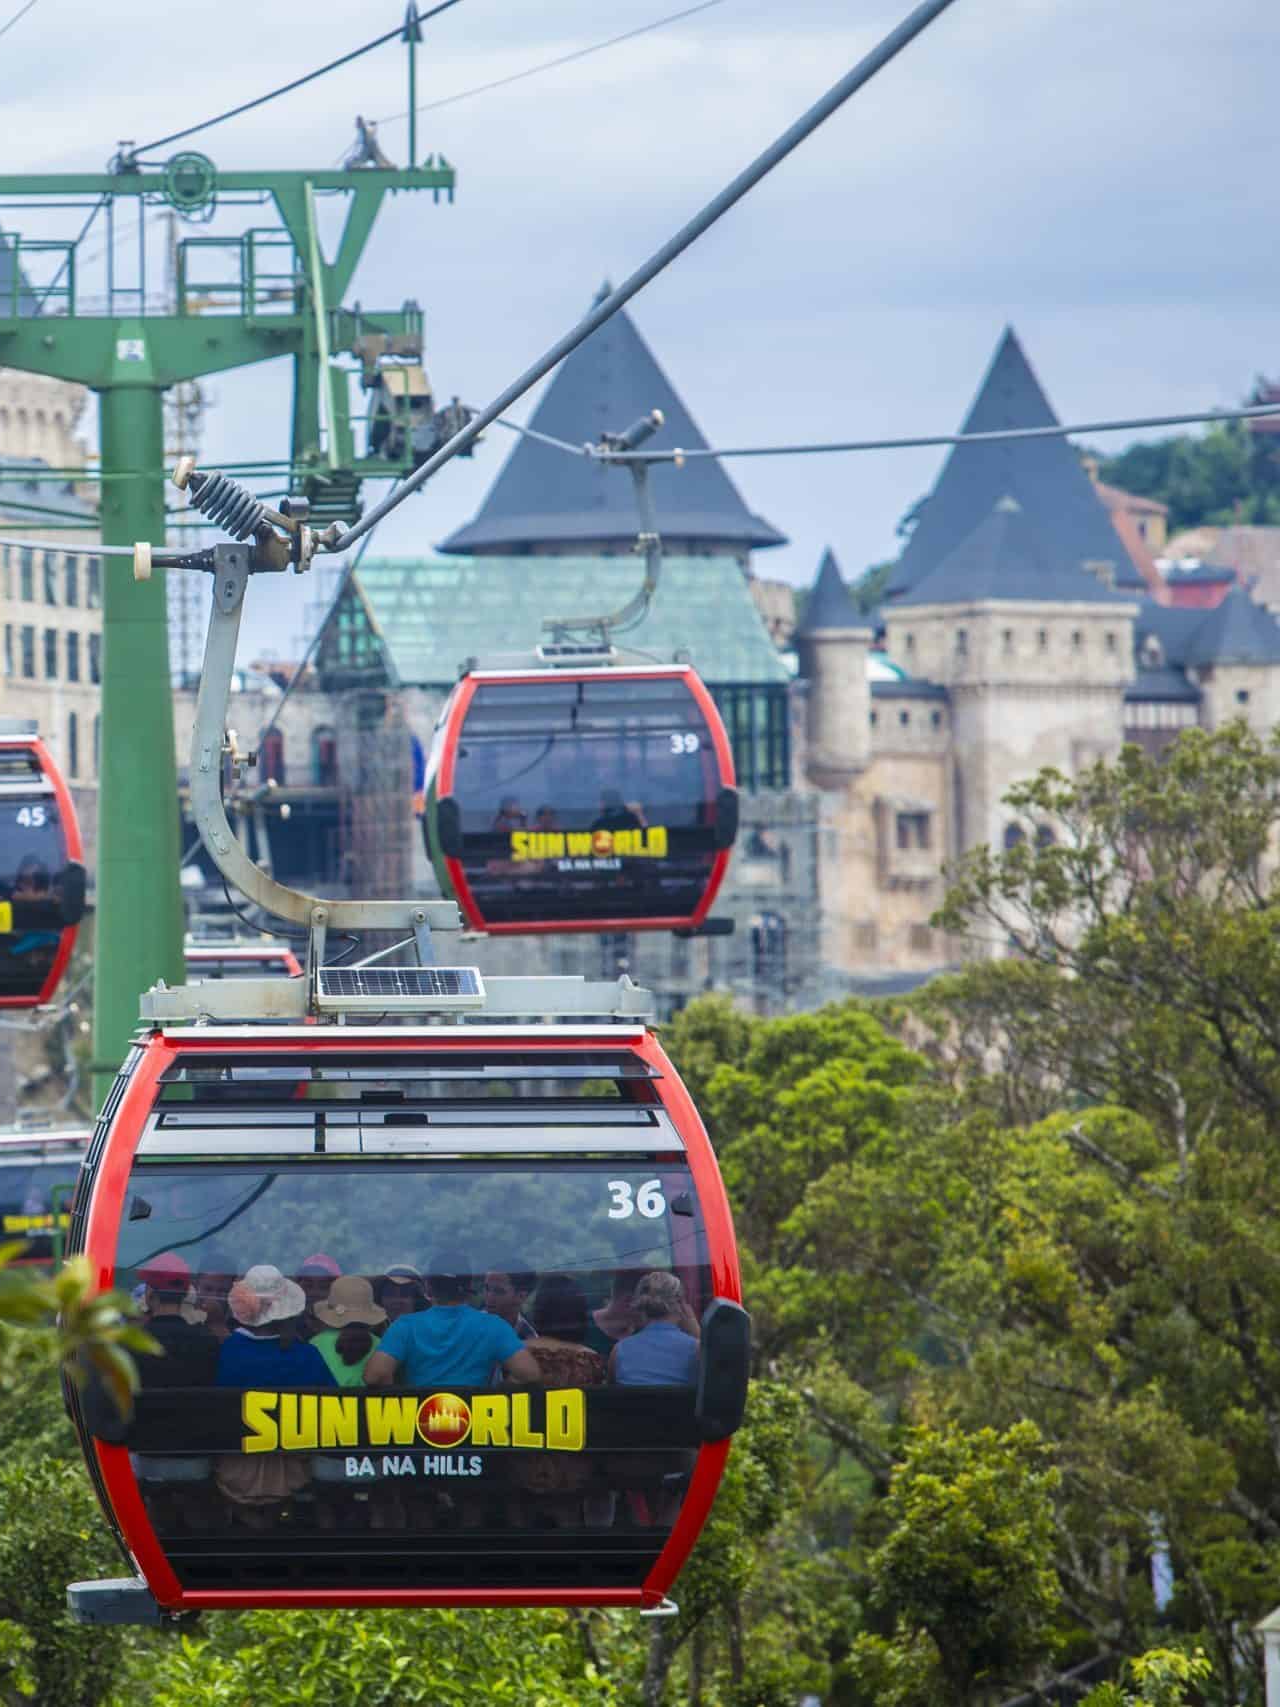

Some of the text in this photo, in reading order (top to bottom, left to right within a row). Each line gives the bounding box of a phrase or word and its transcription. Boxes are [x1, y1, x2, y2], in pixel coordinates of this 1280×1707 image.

[670, 733, 699, 754] 39
[16, 807, 47, 828] 45
[511, 826, 668, 861] SUN WORLD
[607, 1179, 666, 1219] 36
[241, 1389, 586, 1454] SUN WORLD
[345, 1455, 483, 1477] BA NA HILLS
